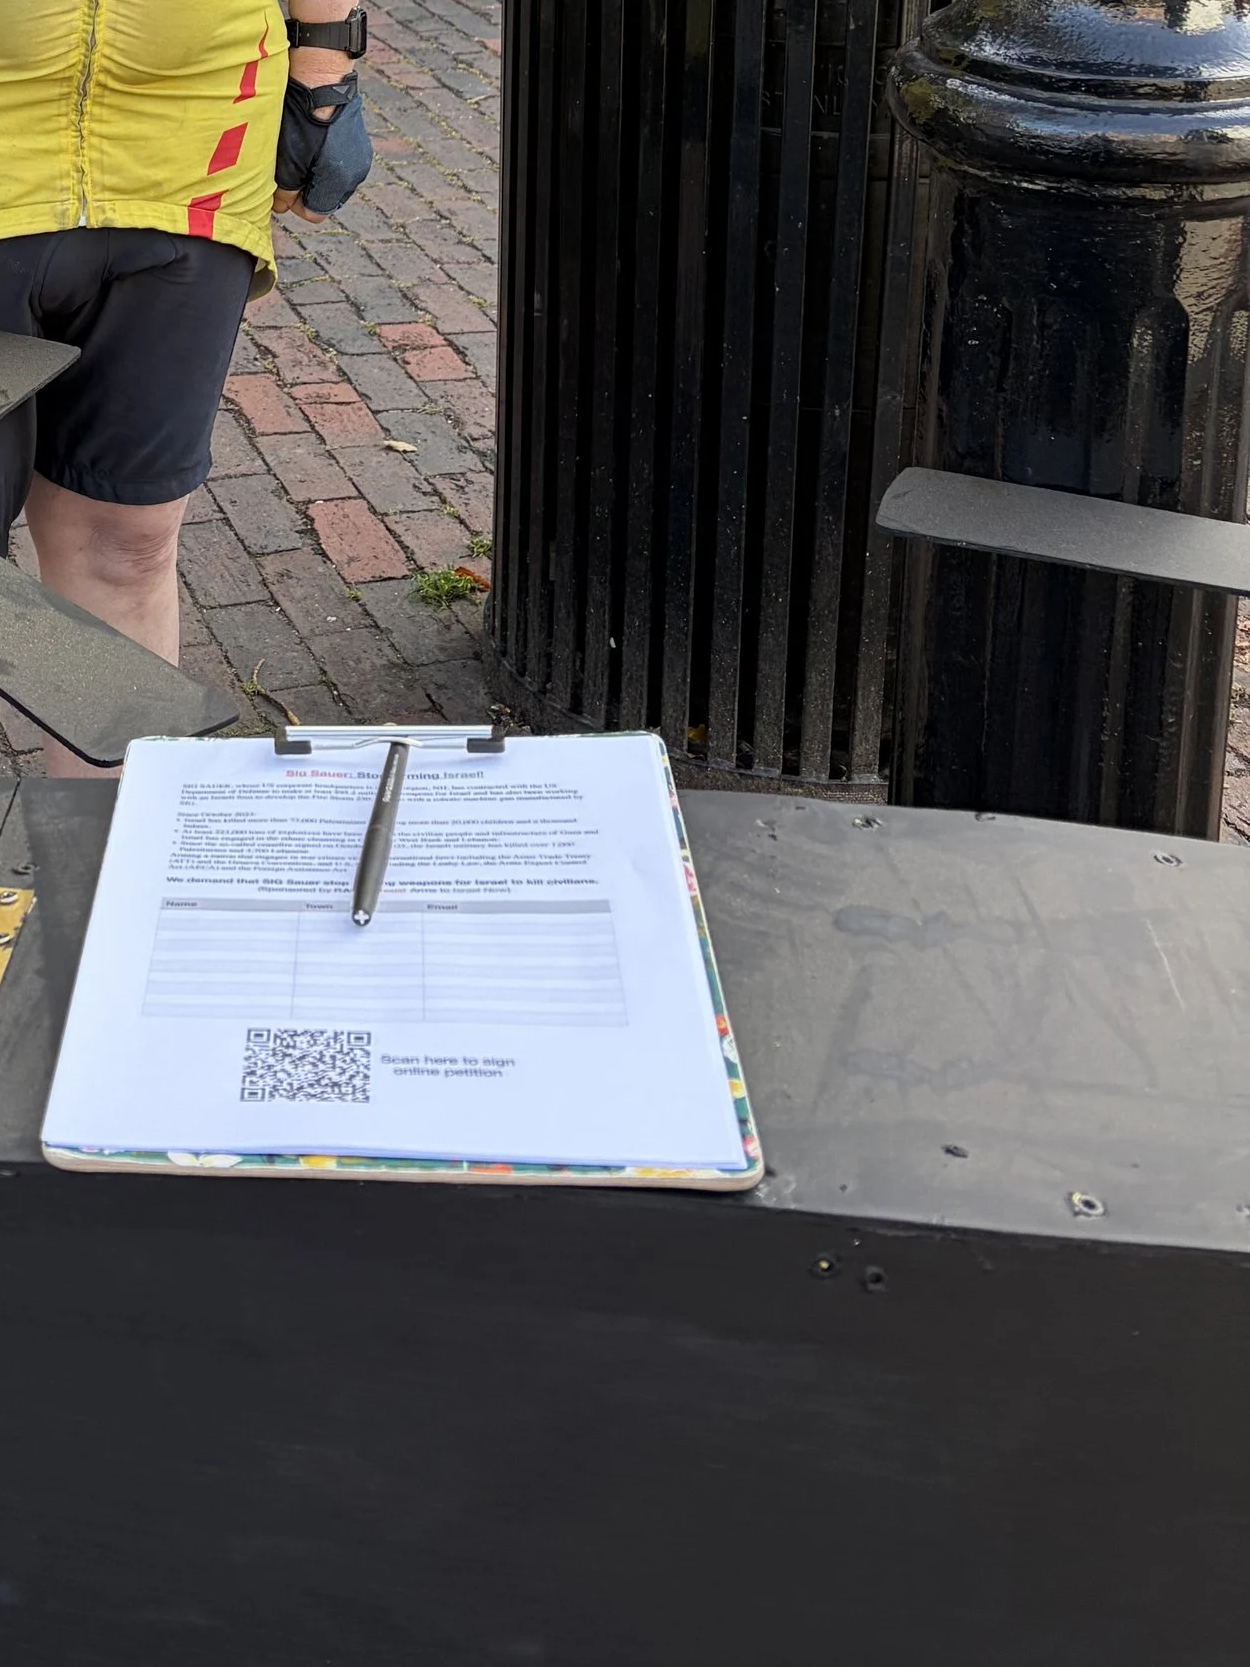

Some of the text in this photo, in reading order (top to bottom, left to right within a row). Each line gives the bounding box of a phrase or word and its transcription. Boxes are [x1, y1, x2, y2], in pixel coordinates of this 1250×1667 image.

[286, 770, 306, 778] Sig
[322, 879, 349, 887] stop
[318, 887, 332, 895] by
[381, 1054, 516, 1069] Scan here to sign
[393, 1066, 504, 1079] online petition
